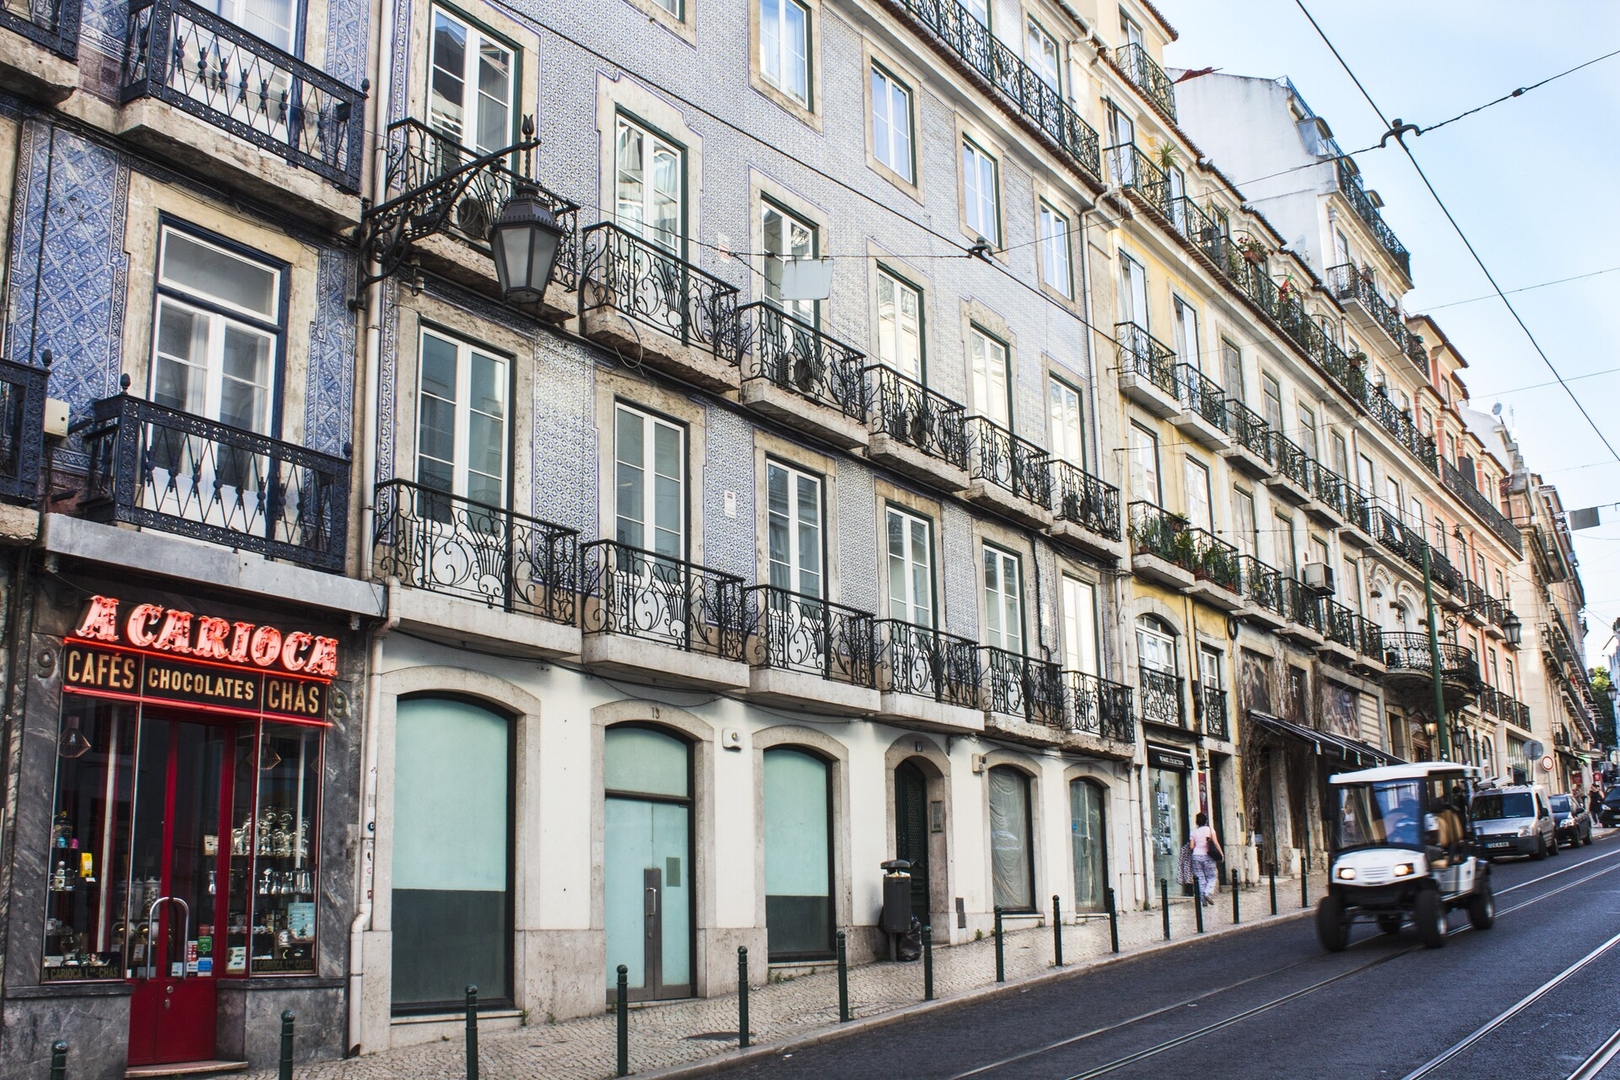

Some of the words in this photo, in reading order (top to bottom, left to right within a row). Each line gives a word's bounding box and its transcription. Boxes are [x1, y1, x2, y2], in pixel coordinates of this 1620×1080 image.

[75, 595, 119, 642] A
[127, 603, 339, 677] CARIOCA
[68, 650, 136, 689] CAFÉS
[148, 666, 255, 701] CHOCOLATES
[268, 681, 320, 714] CHÁS
